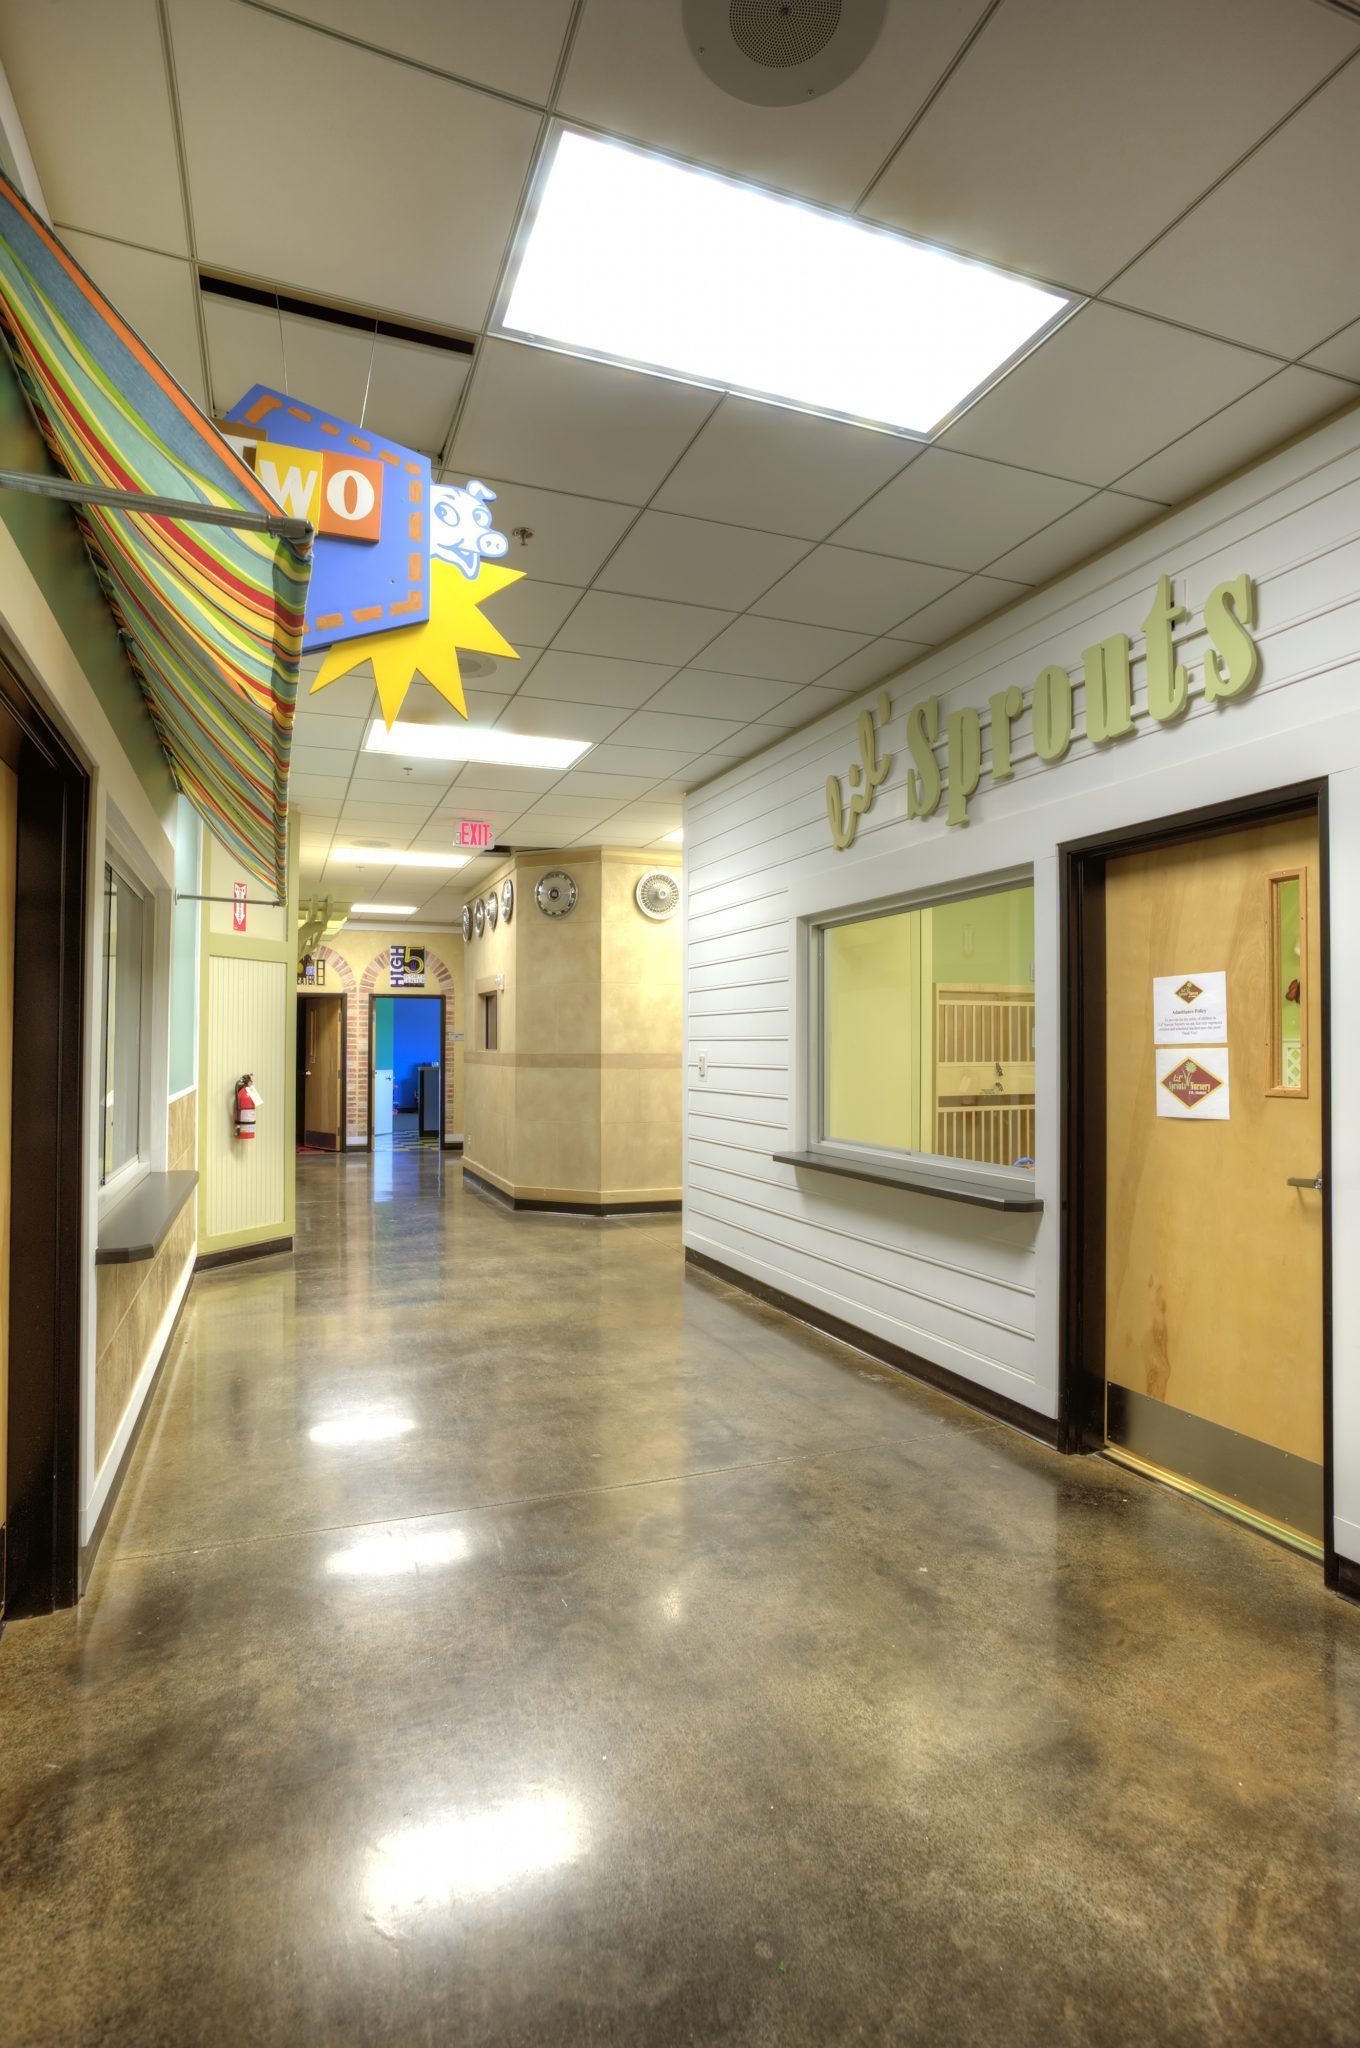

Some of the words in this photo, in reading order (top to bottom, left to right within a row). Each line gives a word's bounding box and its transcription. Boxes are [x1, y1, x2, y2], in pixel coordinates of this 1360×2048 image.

[905, 573, 1258, 829] Sprouts
[461, 822, 490, 846] EXIT
[390, 945, 405, 988] HIGH
[404, 945, 424, 974] 5
